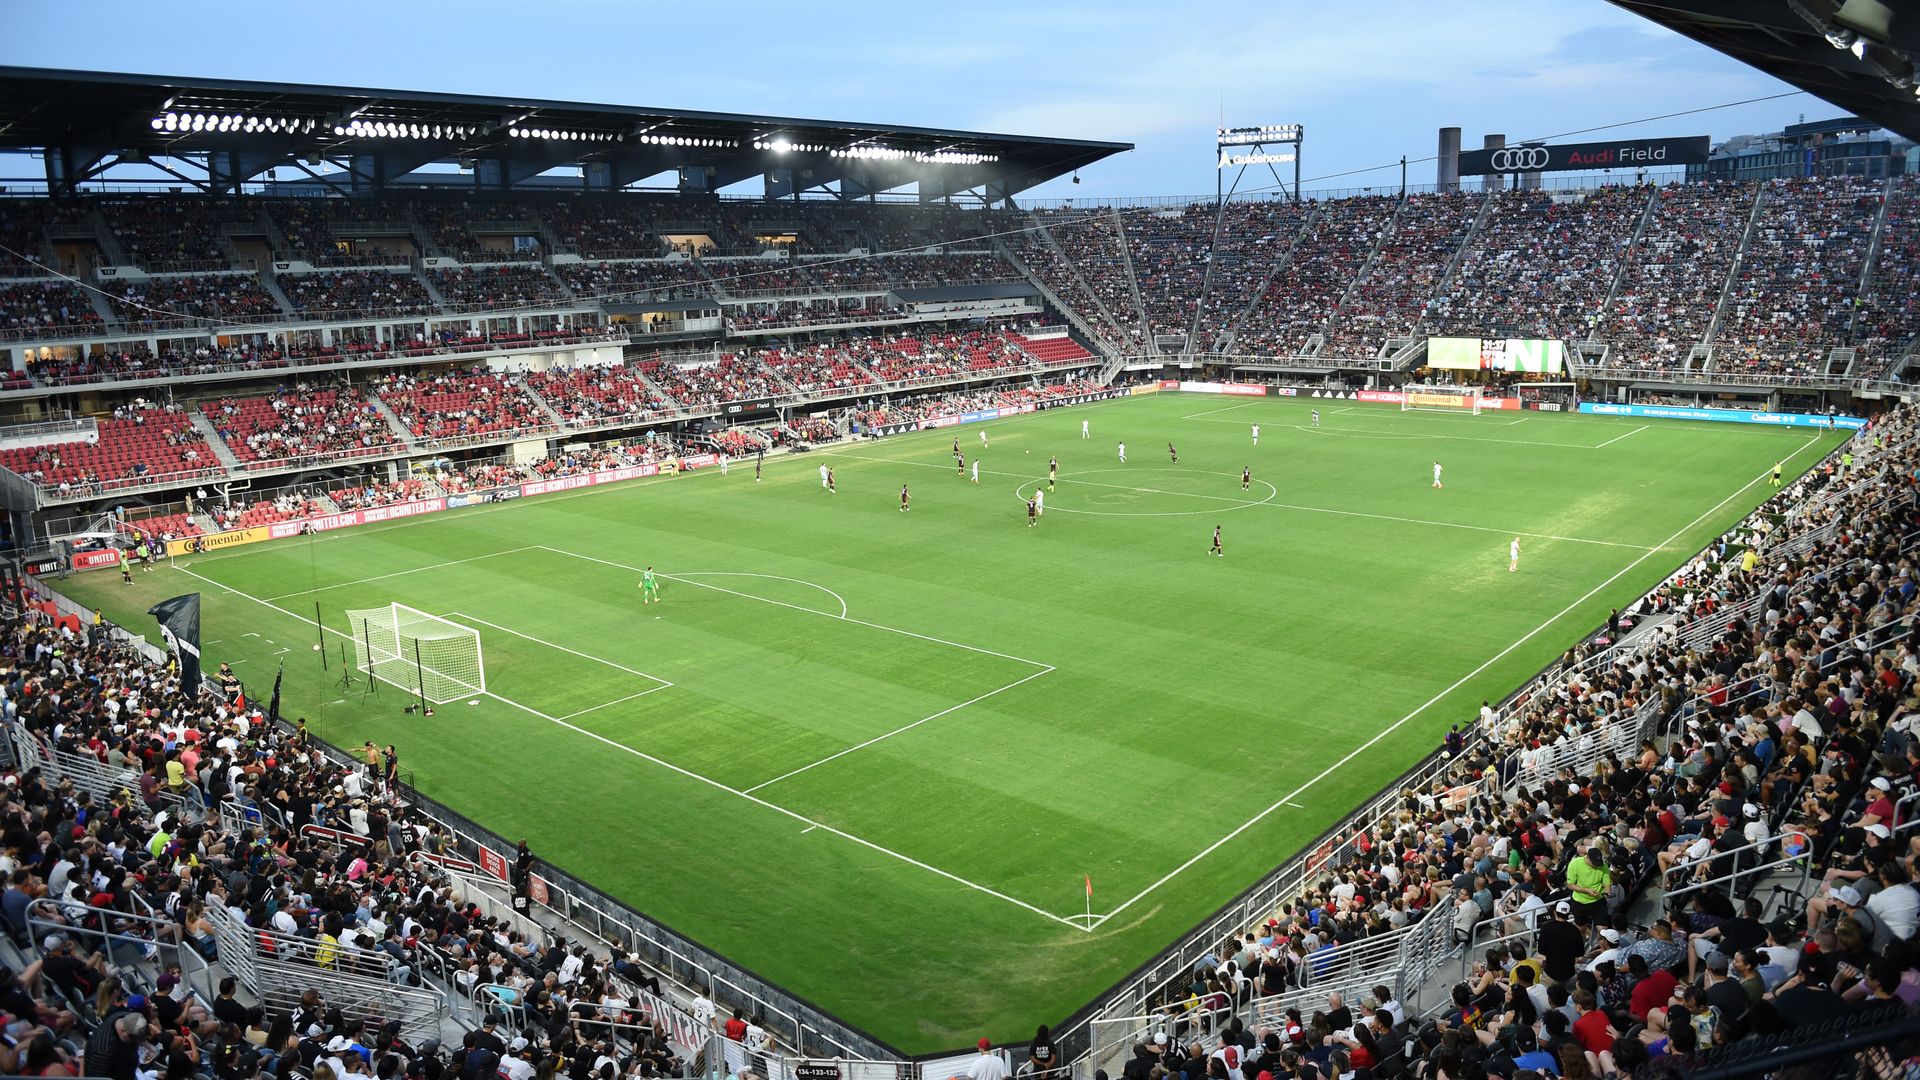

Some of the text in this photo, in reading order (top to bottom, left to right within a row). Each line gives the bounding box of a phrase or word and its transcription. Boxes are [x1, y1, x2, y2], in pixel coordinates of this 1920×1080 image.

[1233, 154, 1295, 165] Guidehouse
[1568, 146, 1666, 164] Audi Field
[1413, 394, 1451, 404] Continental
[1539, 402, 1561, 412] UNITED
[390, 499, 442, 517] DCUNITED.COM
[88, 553, 115, 565] UNITED
[797, 1068, 838, 1076] 134-133-132
